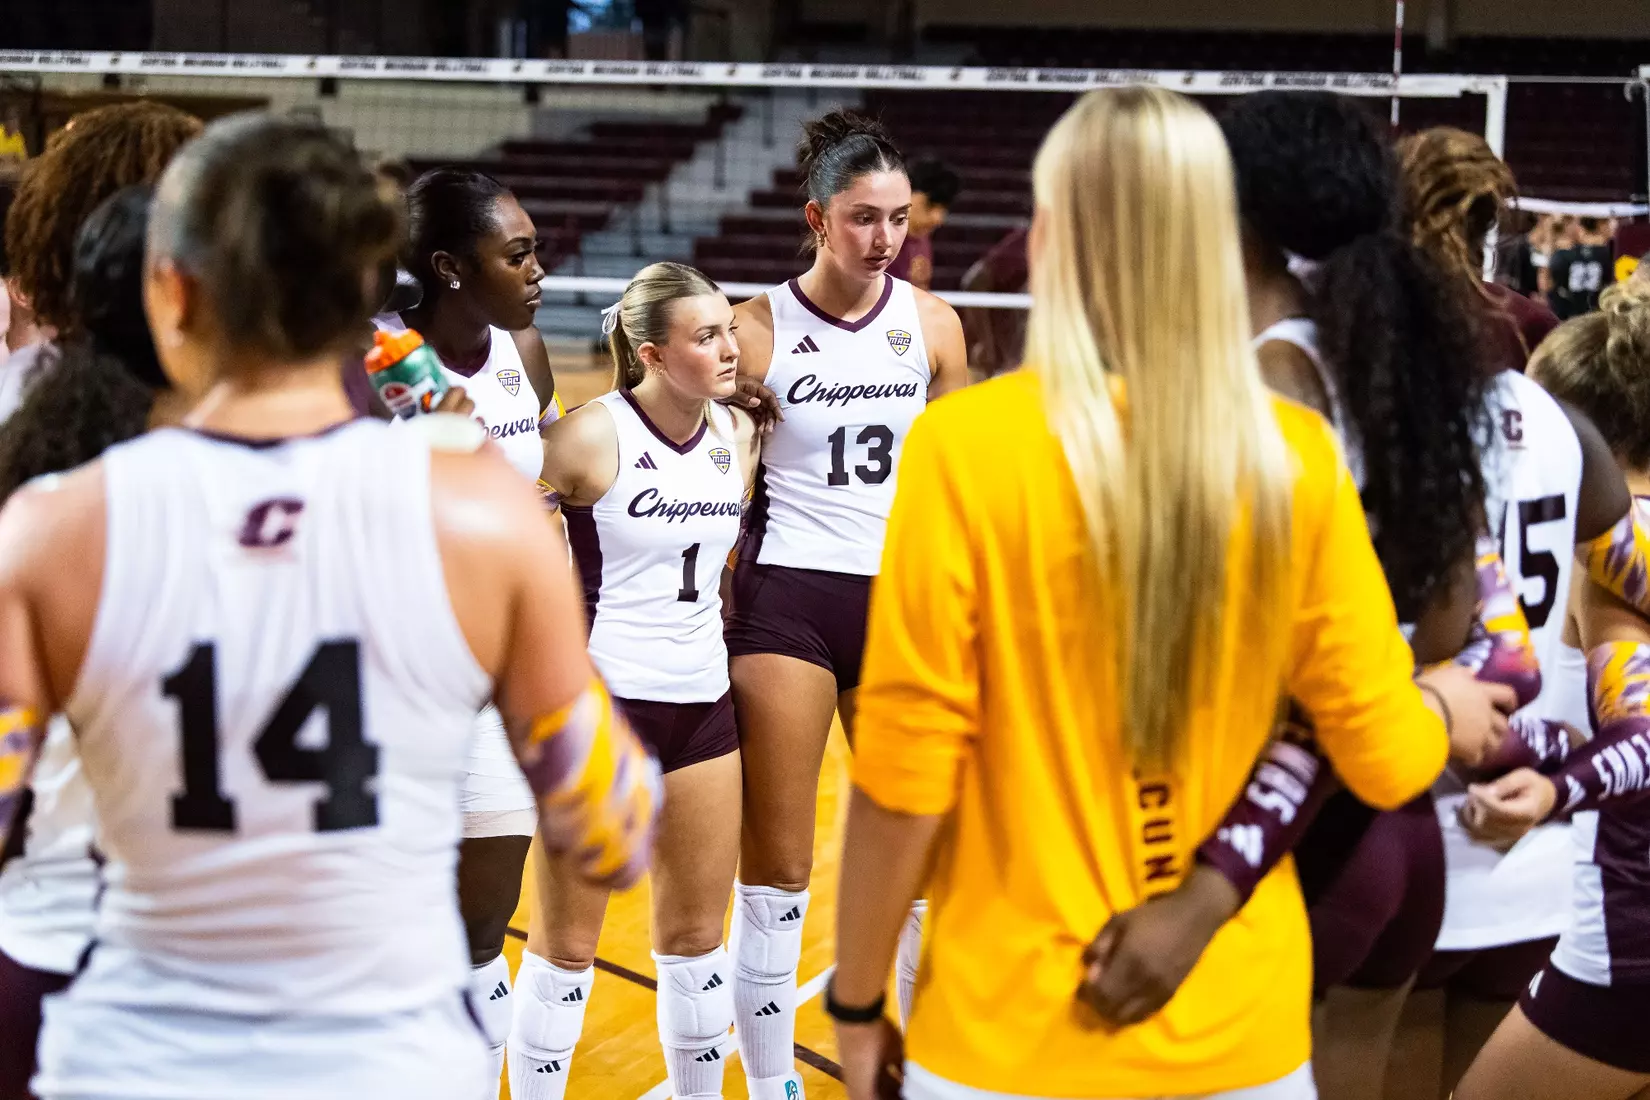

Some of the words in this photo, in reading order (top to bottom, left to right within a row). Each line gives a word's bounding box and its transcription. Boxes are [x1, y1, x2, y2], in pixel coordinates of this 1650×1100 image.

[787, 374, 918, 407] Chippewas
[827, 424, 895, 486] 13
[238, 498, 304, 548] C
[677, 542, 700, 602] 1
[161, 635, 380, 834] 14
